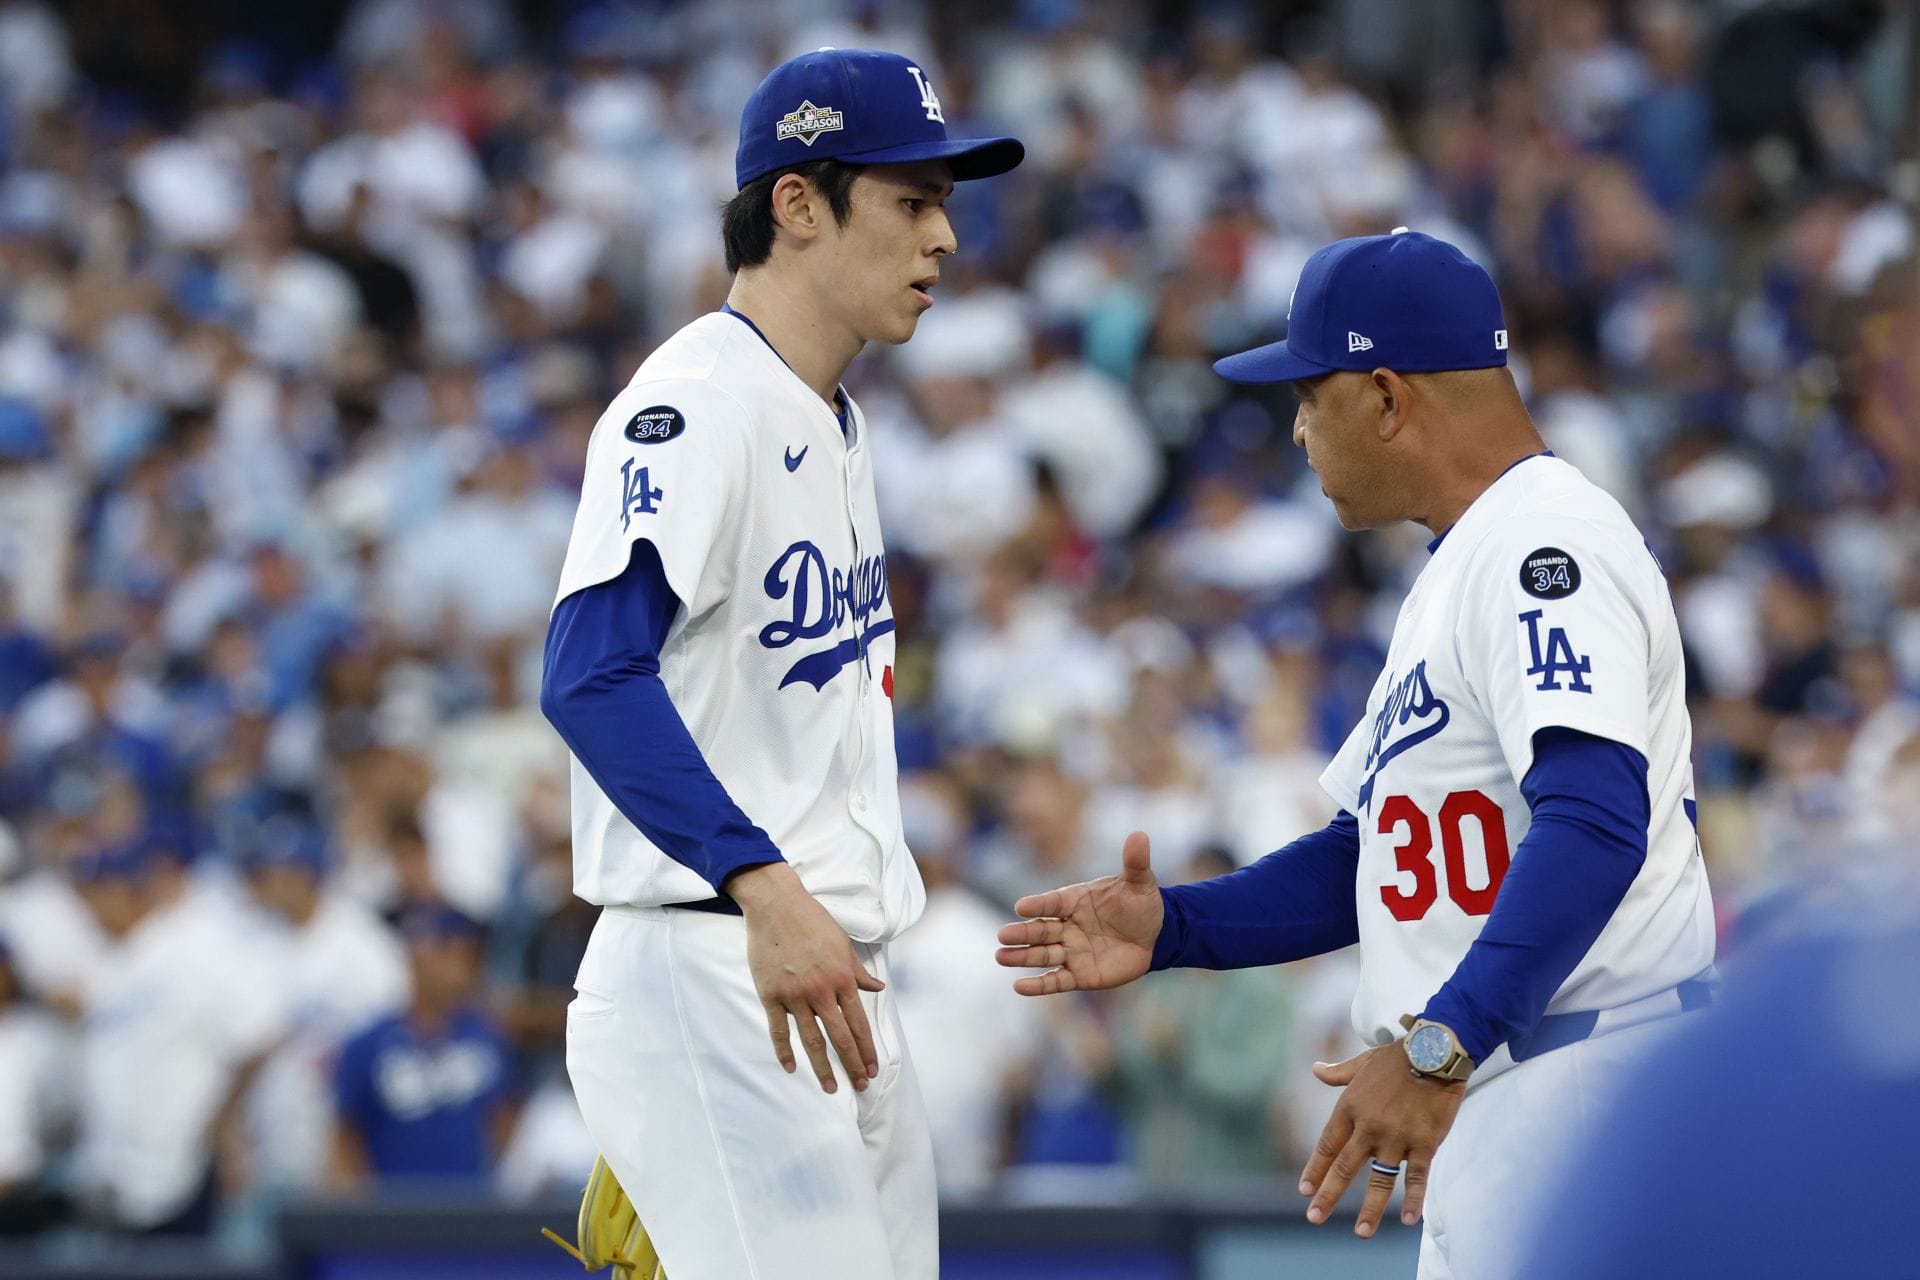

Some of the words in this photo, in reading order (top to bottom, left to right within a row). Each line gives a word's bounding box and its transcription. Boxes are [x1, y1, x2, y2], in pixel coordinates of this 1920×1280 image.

[906, 67, 945, 124] LA
[778, 114, 840, 135] POSTSEASON
[635, 419, 671, 438] 34
[636, 413, 675, 422] FERNANDO
[620, 456, 663, 534] LA
[1528, 556, 1569, 569] FERNANDO
[1532, 565, 1570, 591] 34
[1518, 608, 1592, 694] LA
[1378, 789, 1511, 922] 30
